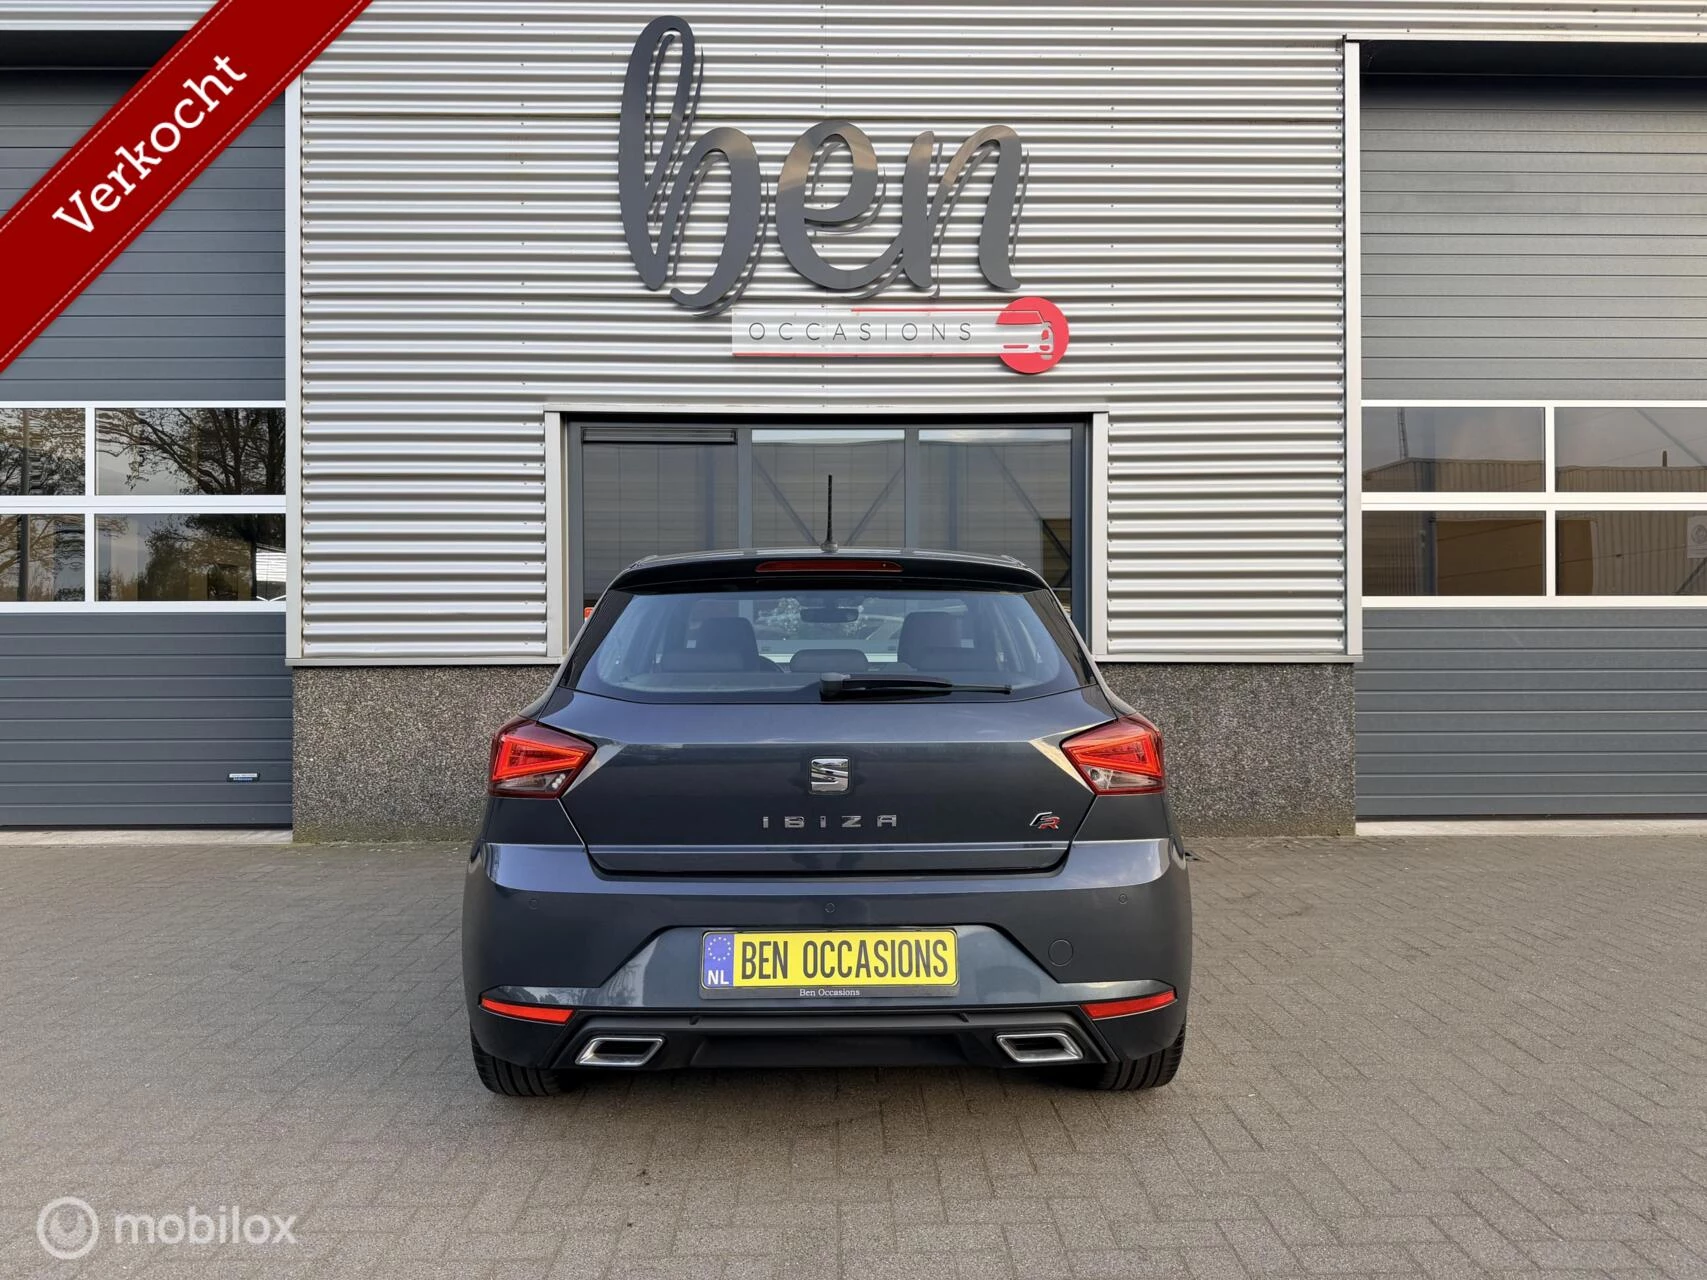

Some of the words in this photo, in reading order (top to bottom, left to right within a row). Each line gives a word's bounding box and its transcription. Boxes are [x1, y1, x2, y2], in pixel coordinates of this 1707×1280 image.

[748, 322, 972, 341] OCCASIONS
[762, 814, 897, 829] IBIZA
[741, 940, 788, 980] BEN
[803, 939, 948, 978] OCCASIONS
[707, 970, 729, 985] NL
[799, 988, 816, 997] Ben
[818, 988, 860, 997] Occasions
